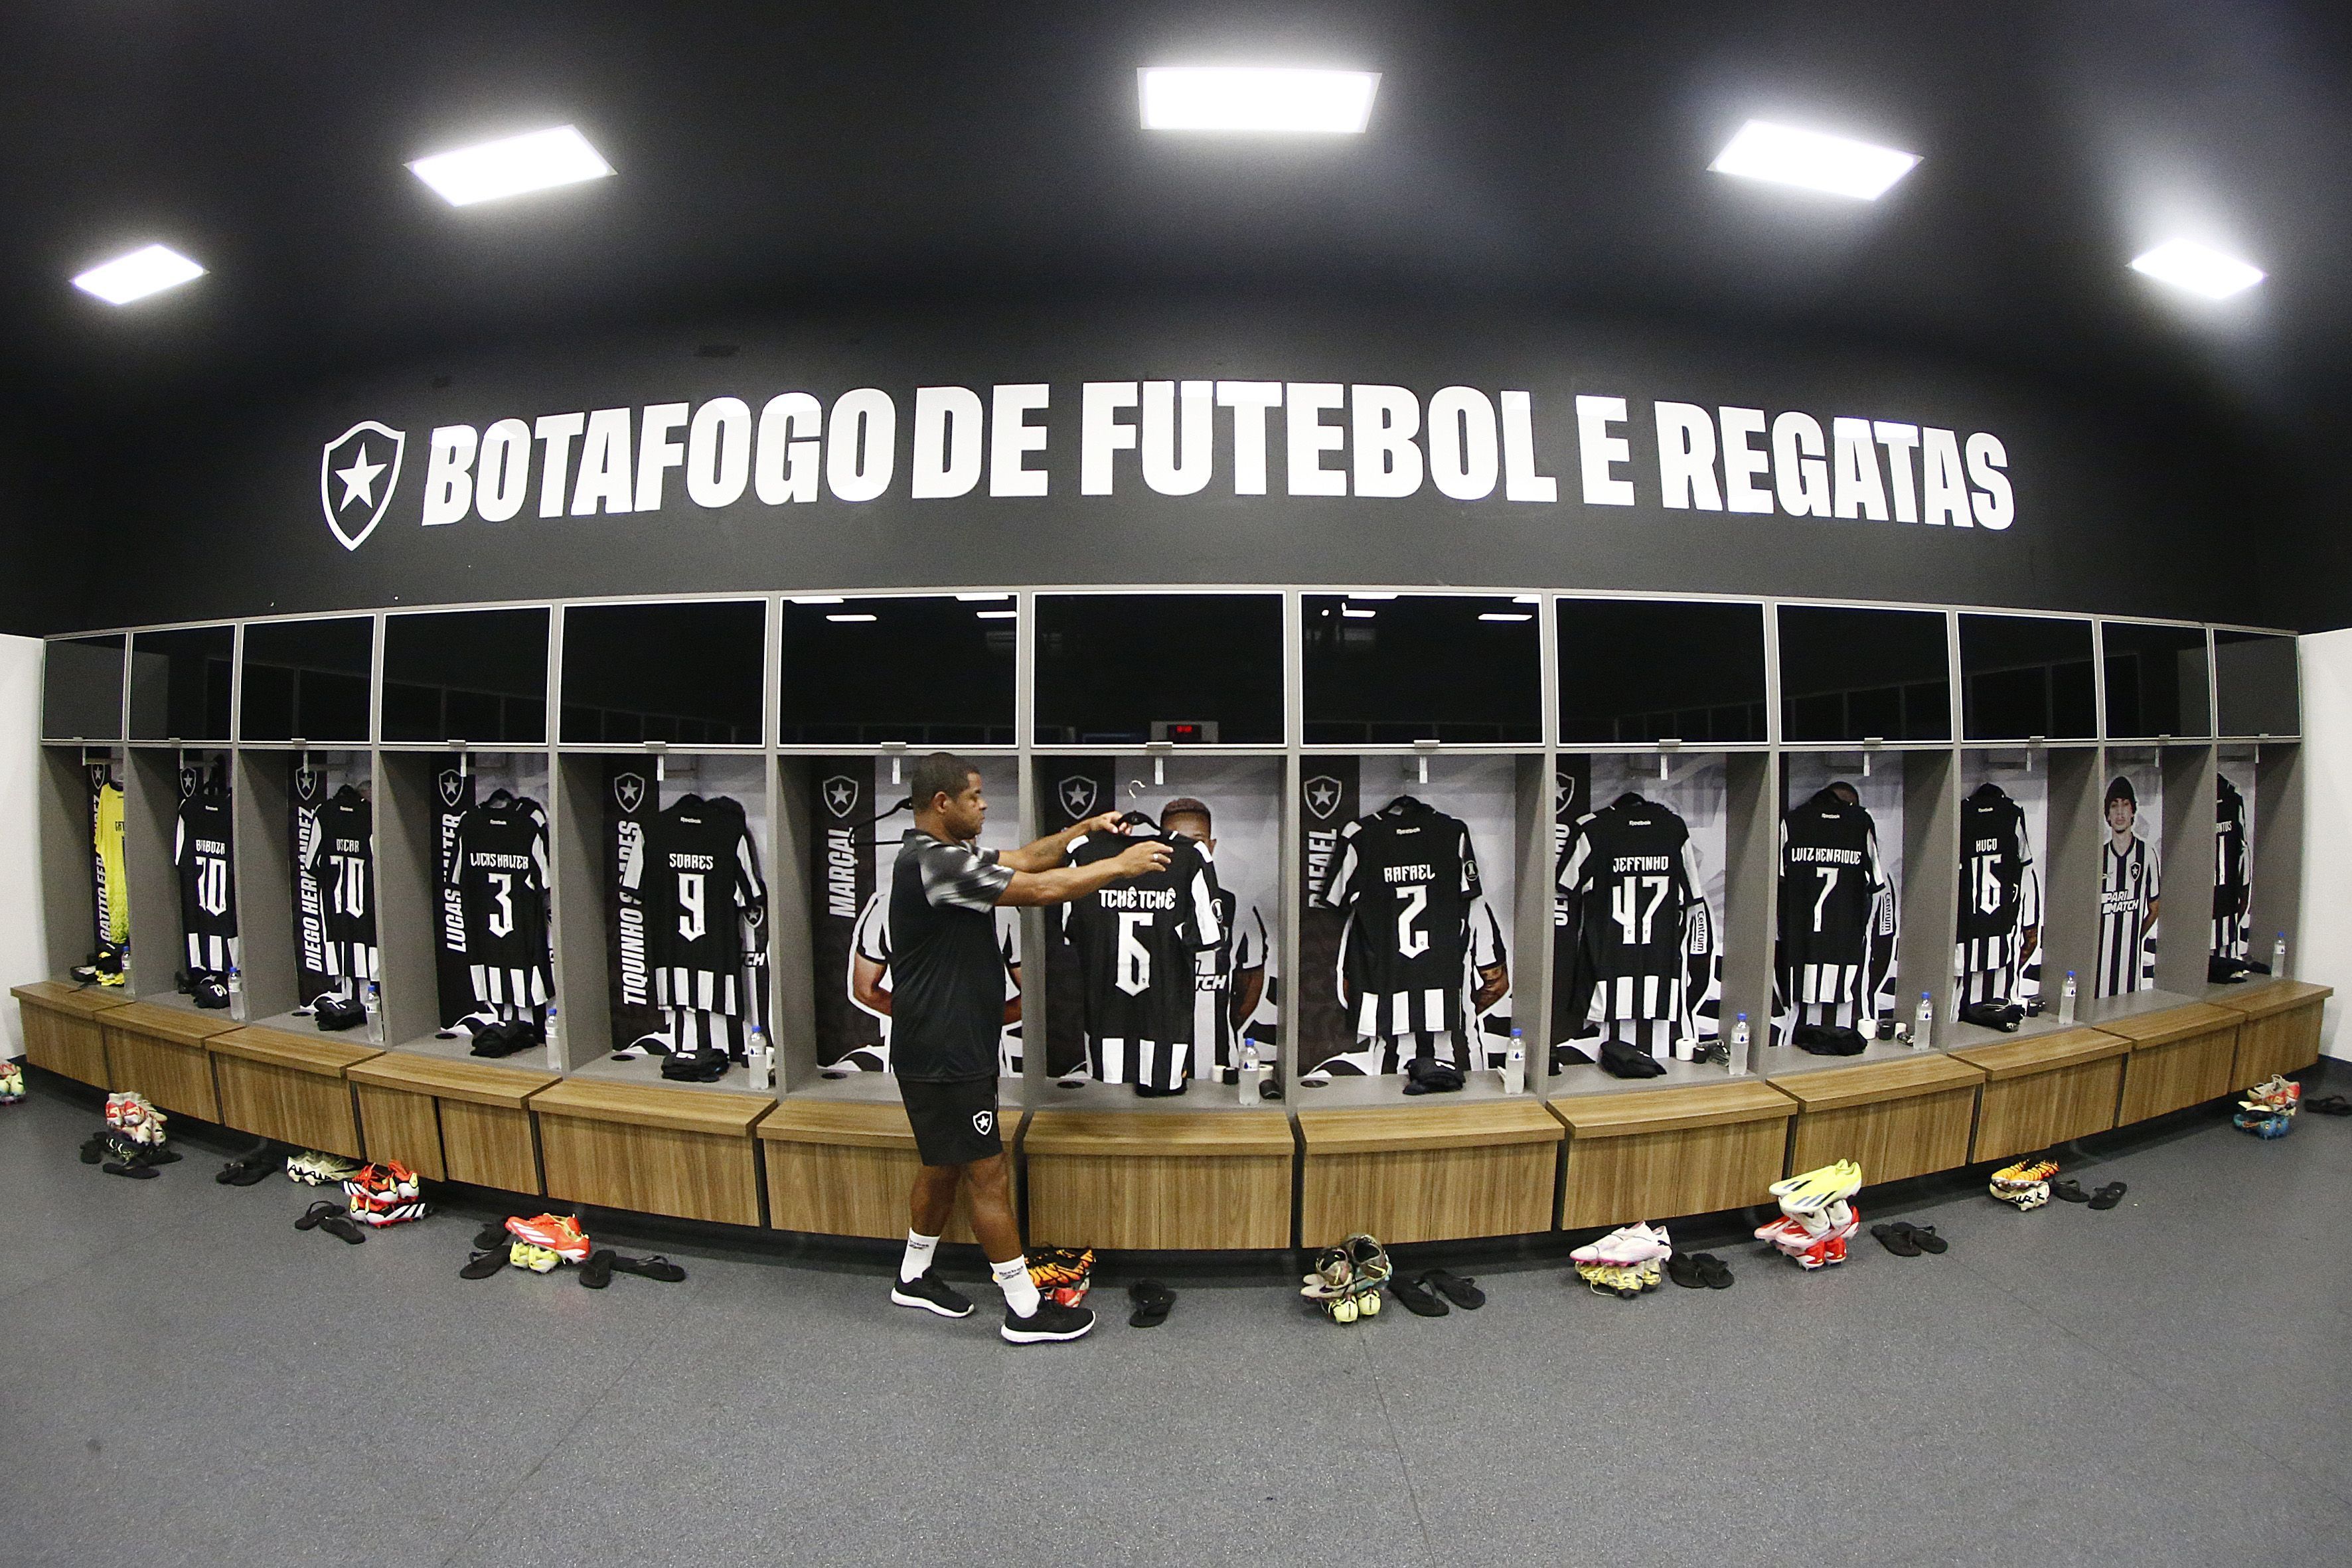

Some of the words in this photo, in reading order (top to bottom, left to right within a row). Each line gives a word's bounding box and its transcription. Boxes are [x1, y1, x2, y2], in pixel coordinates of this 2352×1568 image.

[422, 388, 896, 526] BOTAFOGO
[912, 384, 1049, 499] DE
[1081, 380, 1557, 503] FUTEBOL
[1576, 395, 1634, 506] E
[1654, 401, 2015, 530] REGATAS
[196, 839, 225, 854] BBOZA
[337, 838, 359, 852] OSCAR
[497, 854, 528, 870] HALTER
[669, 853, 713, 870] SOARES
[828, 827, 858, 918] MARÇAL
[1612, 856, 1669, 873] JEFFINHO
[1792, 847, 1814, 862] LUIZ
[1816, 848, 1861, 865] HENRIQUE
[1976, 838, 1998, 853] HUGO
[329, 856, 365, 918] 70
[1099, 886, 1137, 908] TCHÊ
[1138, 887, 1176, 910] TCHÊ
[1383, 864, 1435, 883] RAFAEL
[1814, 866, 1839, 932] 7
[1971, 854, 2002, 915] 16
[2101, 890, 2128, 903] PARI
[445, 888, 466, 953] LUCAS
[488, 873, 514, 938] 3
[678, 873, 706, 941] 9
[1395, 884, 1430, 959] 2
[1612, 876, 1670, 945] 47
[1696, 910, 1705, 952] Centrum
[2102, 899, 2140, 914] MATCH
[303, 917, 323, 972] DIEGO
[619, 907, 648, 1005] TIQUINHO
[1115, 911, 1154, 996] 6
